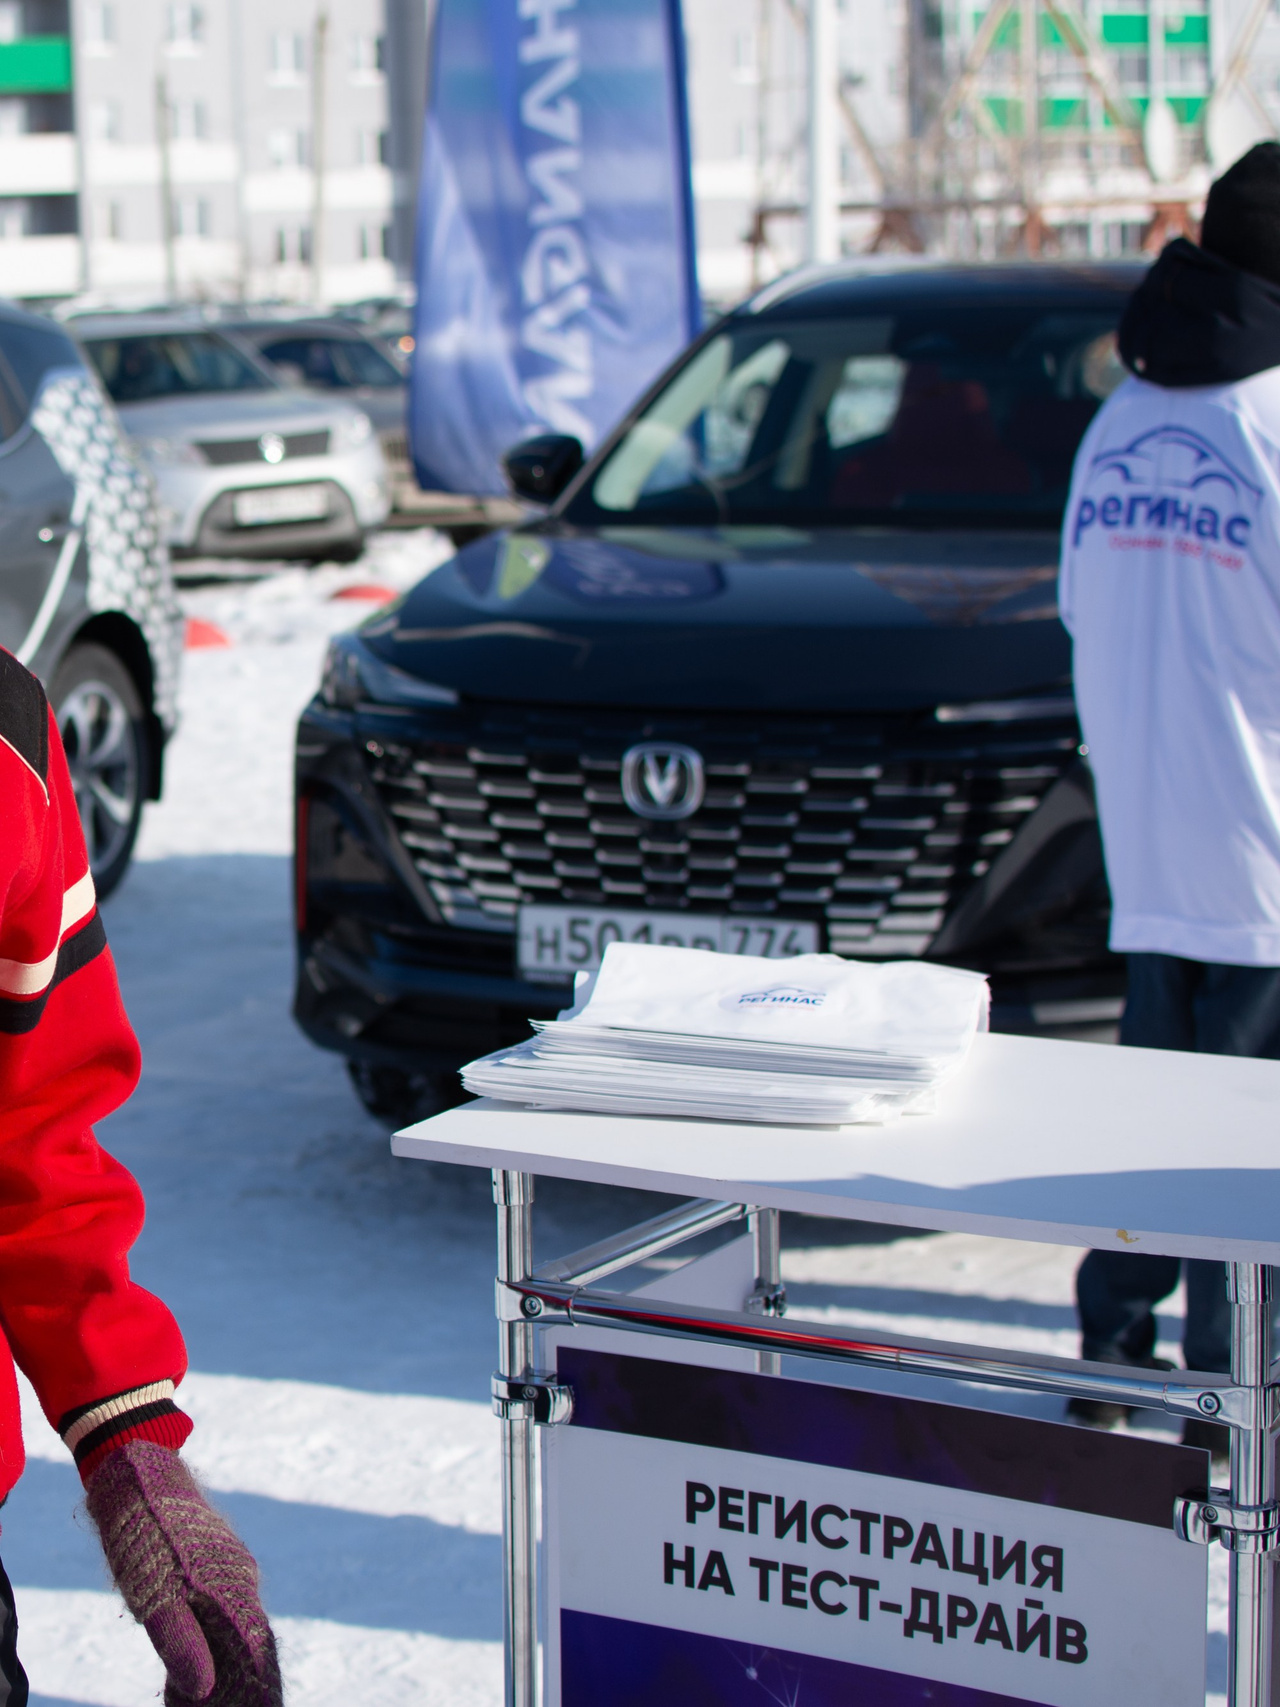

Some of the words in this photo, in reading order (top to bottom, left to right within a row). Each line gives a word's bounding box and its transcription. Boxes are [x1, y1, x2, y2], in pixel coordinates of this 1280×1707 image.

[685, 1480, 1065, 1593] РЕГИСТРАЦИЯ
[663, 1541, 736, 1596] НА
[748, 1556, 1089, 1665] ТЕСТ-ДРАЙВ
